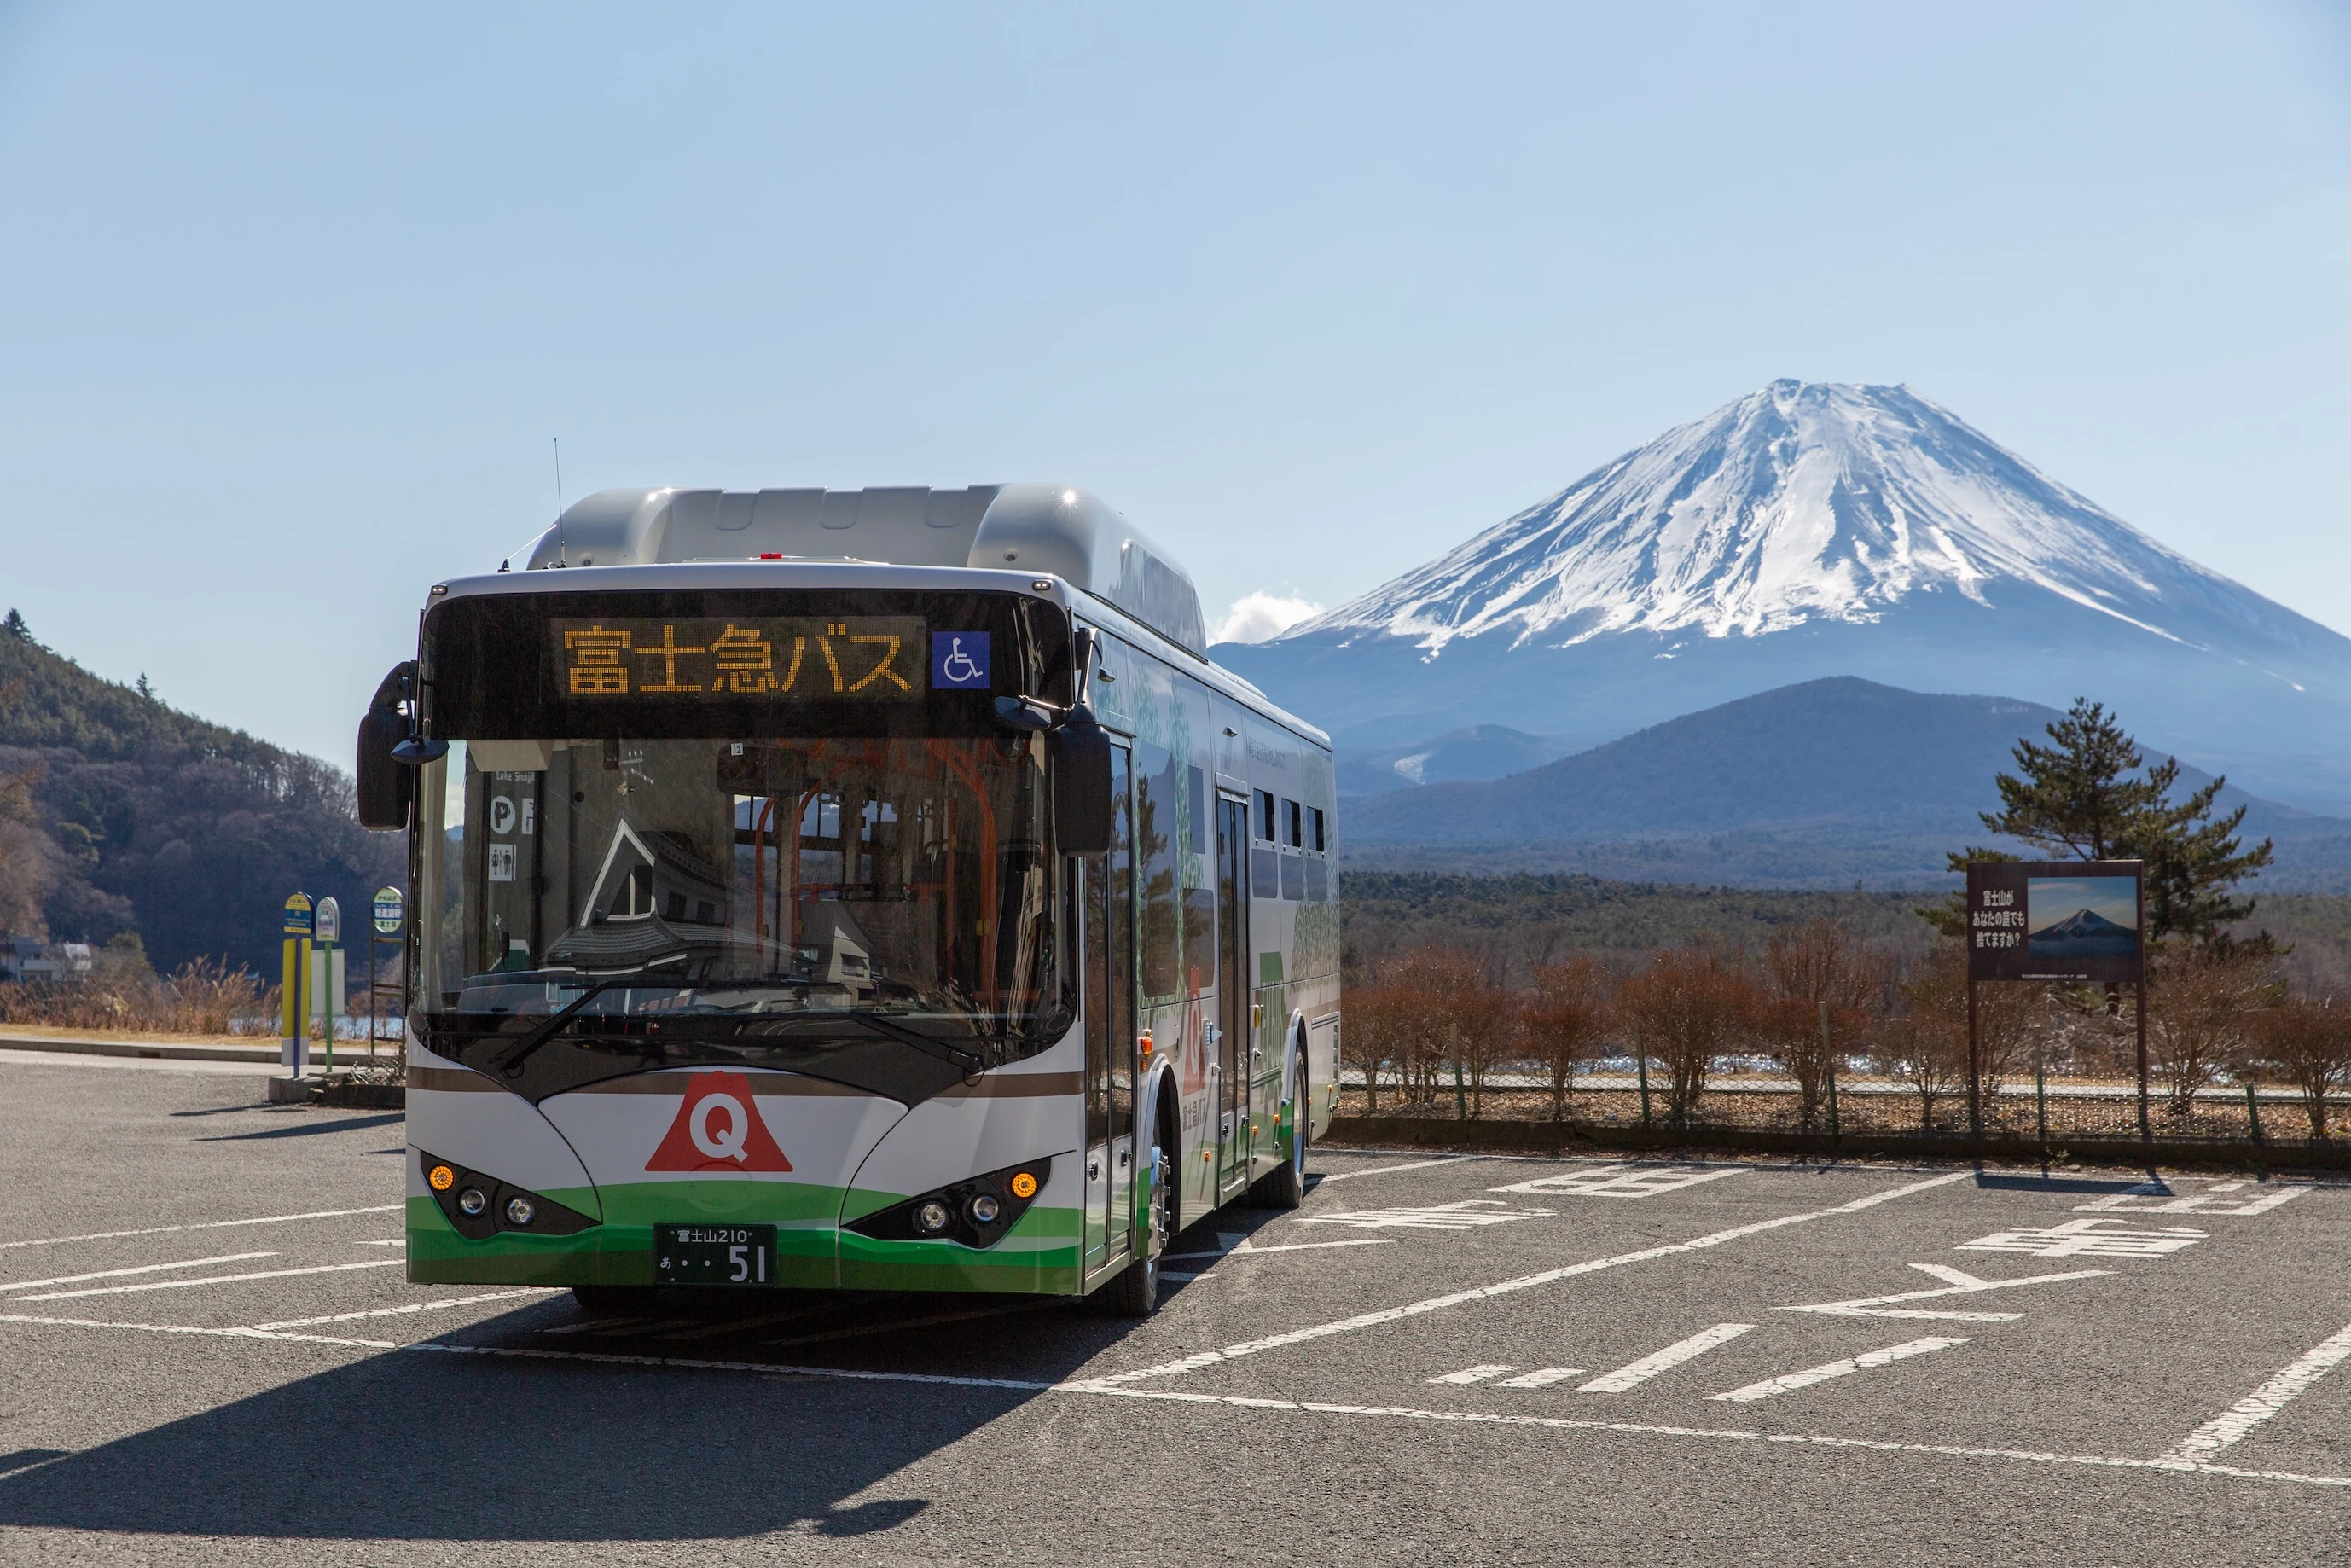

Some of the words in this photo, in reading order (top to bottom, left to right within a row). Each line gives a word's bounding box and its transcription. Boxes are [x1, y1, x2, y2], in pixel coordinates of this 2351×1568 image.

[563, 624, 912, 694] 富士急バス
[736, 746, 741, 754] 2
[494, 800, 511, 828] P
[1982, 889, 2014, 907] 富士山が
[1972, 910, 2025, 927] あなたの庭でも
[1976, 932, 2021, 948] 捨てますか?
[689, 1093, 748, 1164] Q
[676, 1228, 748, 1244] 富士山210
